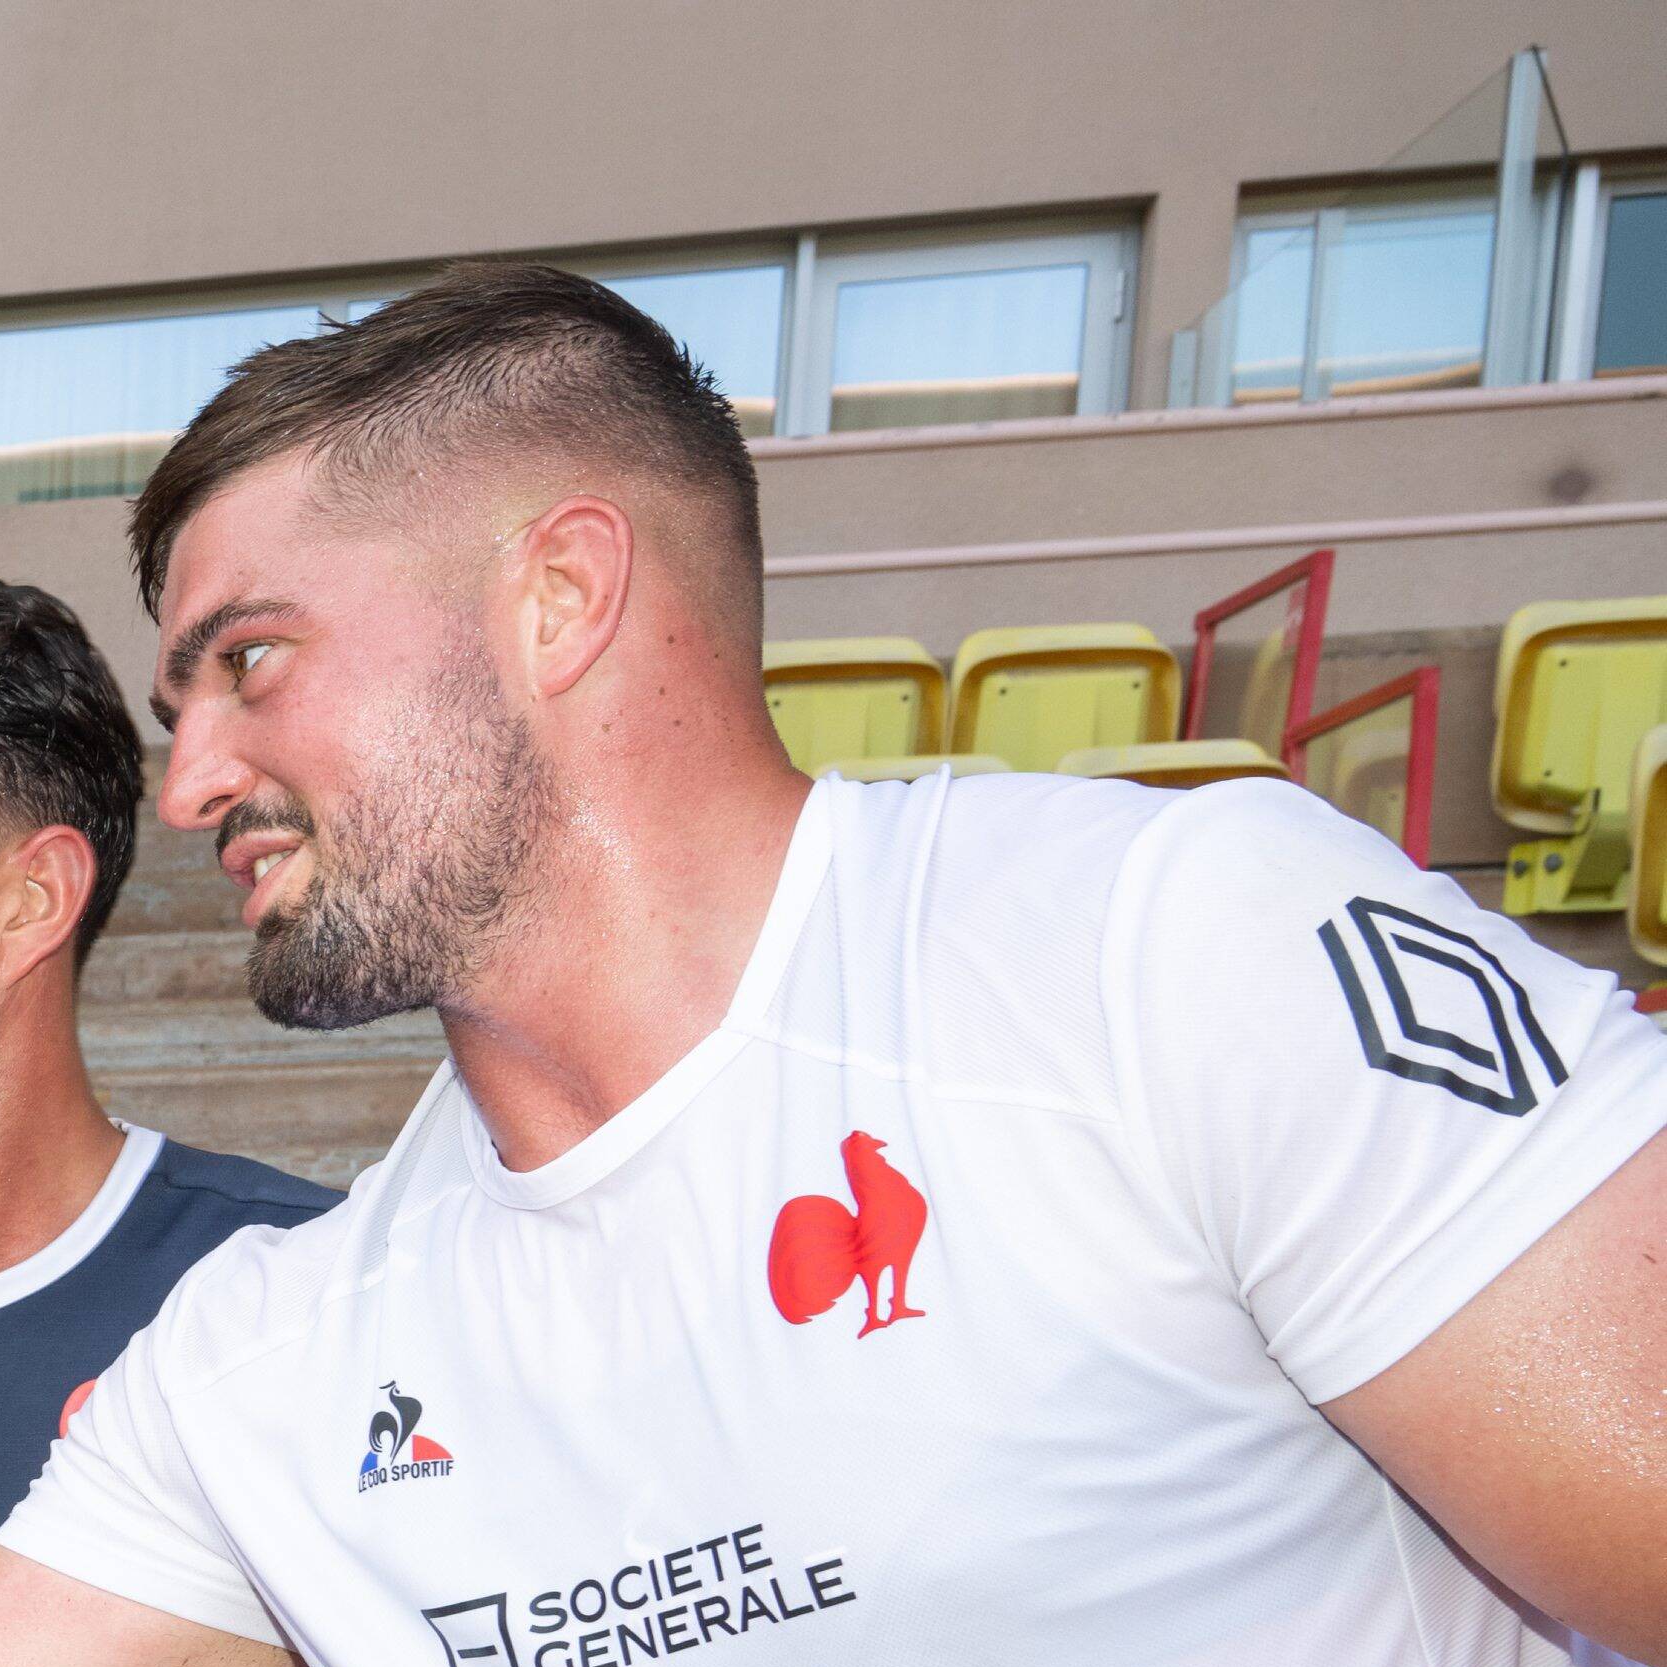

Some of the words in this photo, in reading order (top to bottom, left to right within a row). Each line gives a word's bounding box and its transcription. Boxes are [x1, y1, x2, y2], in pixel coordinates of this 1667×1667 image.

[367, 1467, 388, 1488] COQ
[391, 1460, 454, 1481] SPORTIF
[528, 1523, 773, 1635] SOCIETE
